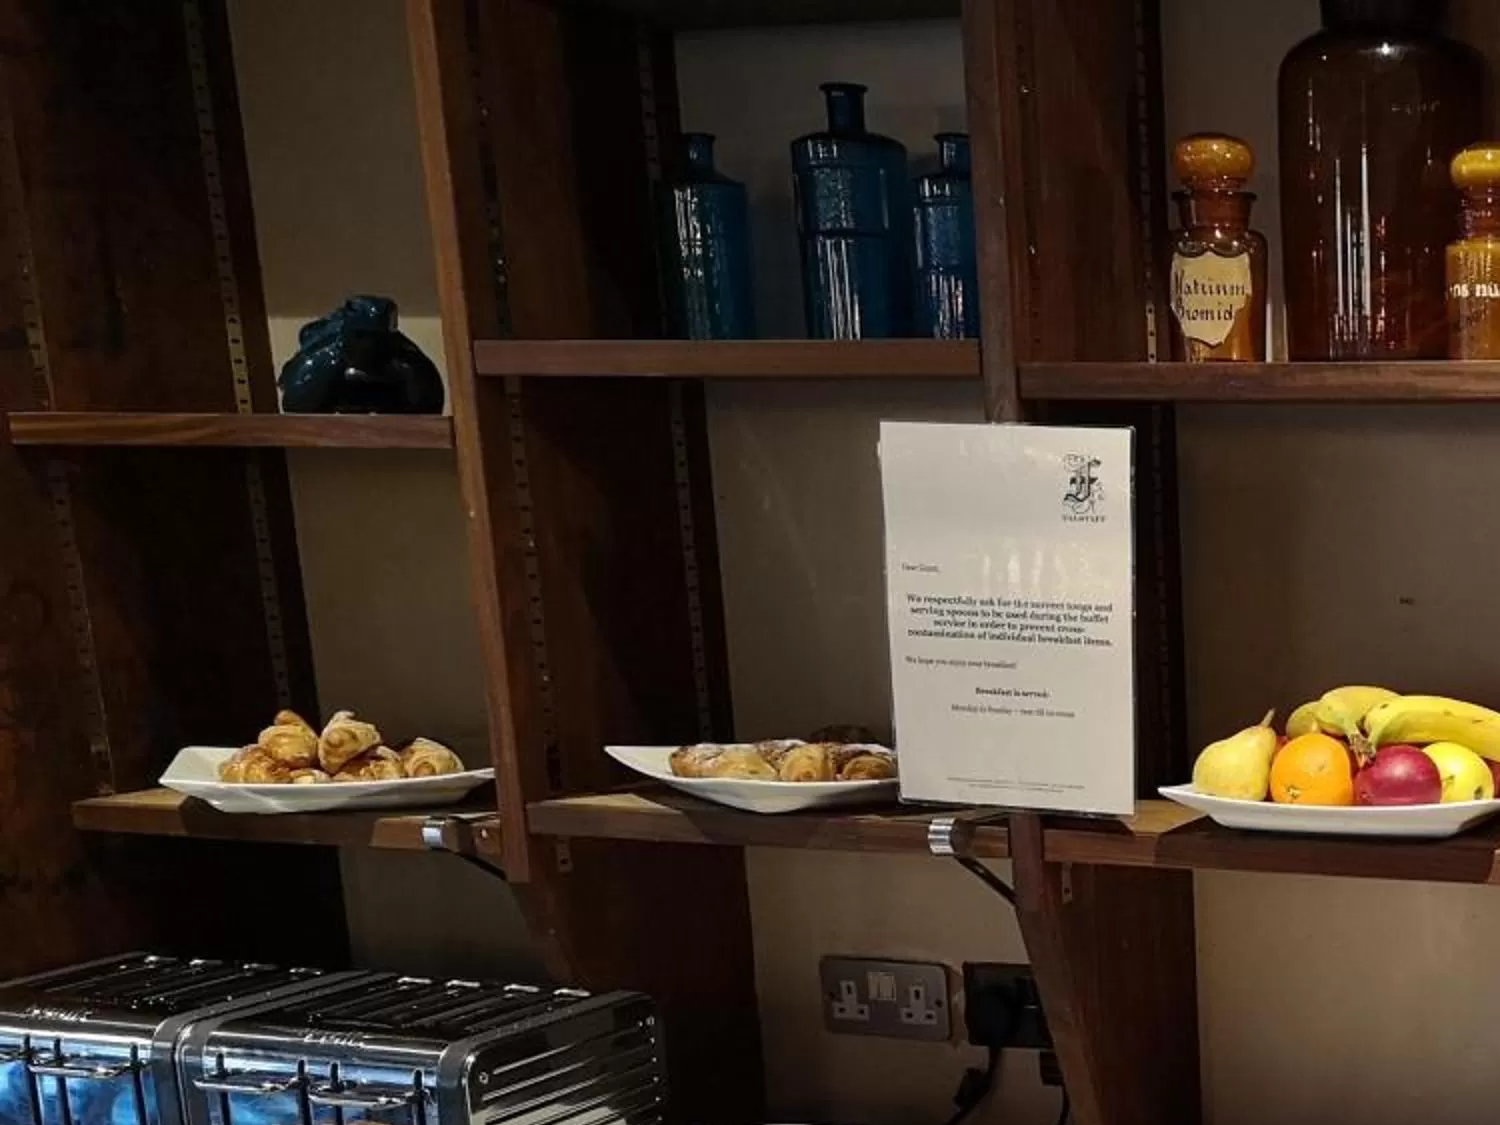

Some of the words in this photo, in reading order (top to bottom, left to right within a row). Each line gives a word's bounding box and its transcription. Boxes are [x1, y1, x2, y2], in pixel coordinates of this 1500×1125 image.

[907, 595, 922, 604] We
[924, 595, 977, 607] respectfully
[979, 597, 995, 607] ask
[997, 597, 1012, 607] for
[1013, 599, 1029, 609] the
[1066, 602, 1093, 613] tongs
[1094, 602, 1113, 612] and
[910, 606, 945, 617] serving
[946, 608, 979, 619] spoons
[980, 609, 991, 617] to
[991, 609, 1003, 618] be
[1005, 610, 1027, 619] used
[1029, 610, 1062, 623] during
[1063, 612, 1078, 622] the
[1080, 612, 1109, 623] buffet
[932, 619, 966, 628] service
[979, 620, 1006, 630] order
[1007, 621, 1018, 631] to
[1019, 622, 1055, 633] prevent
[907, 628, 976, 639] contamination
[977, 630, 987, 640] of
[988, 631, 1037, 643] individual
[1037, 633, 1082, 645] breakfast
[975, 687, 1012, 697] Breakfast
